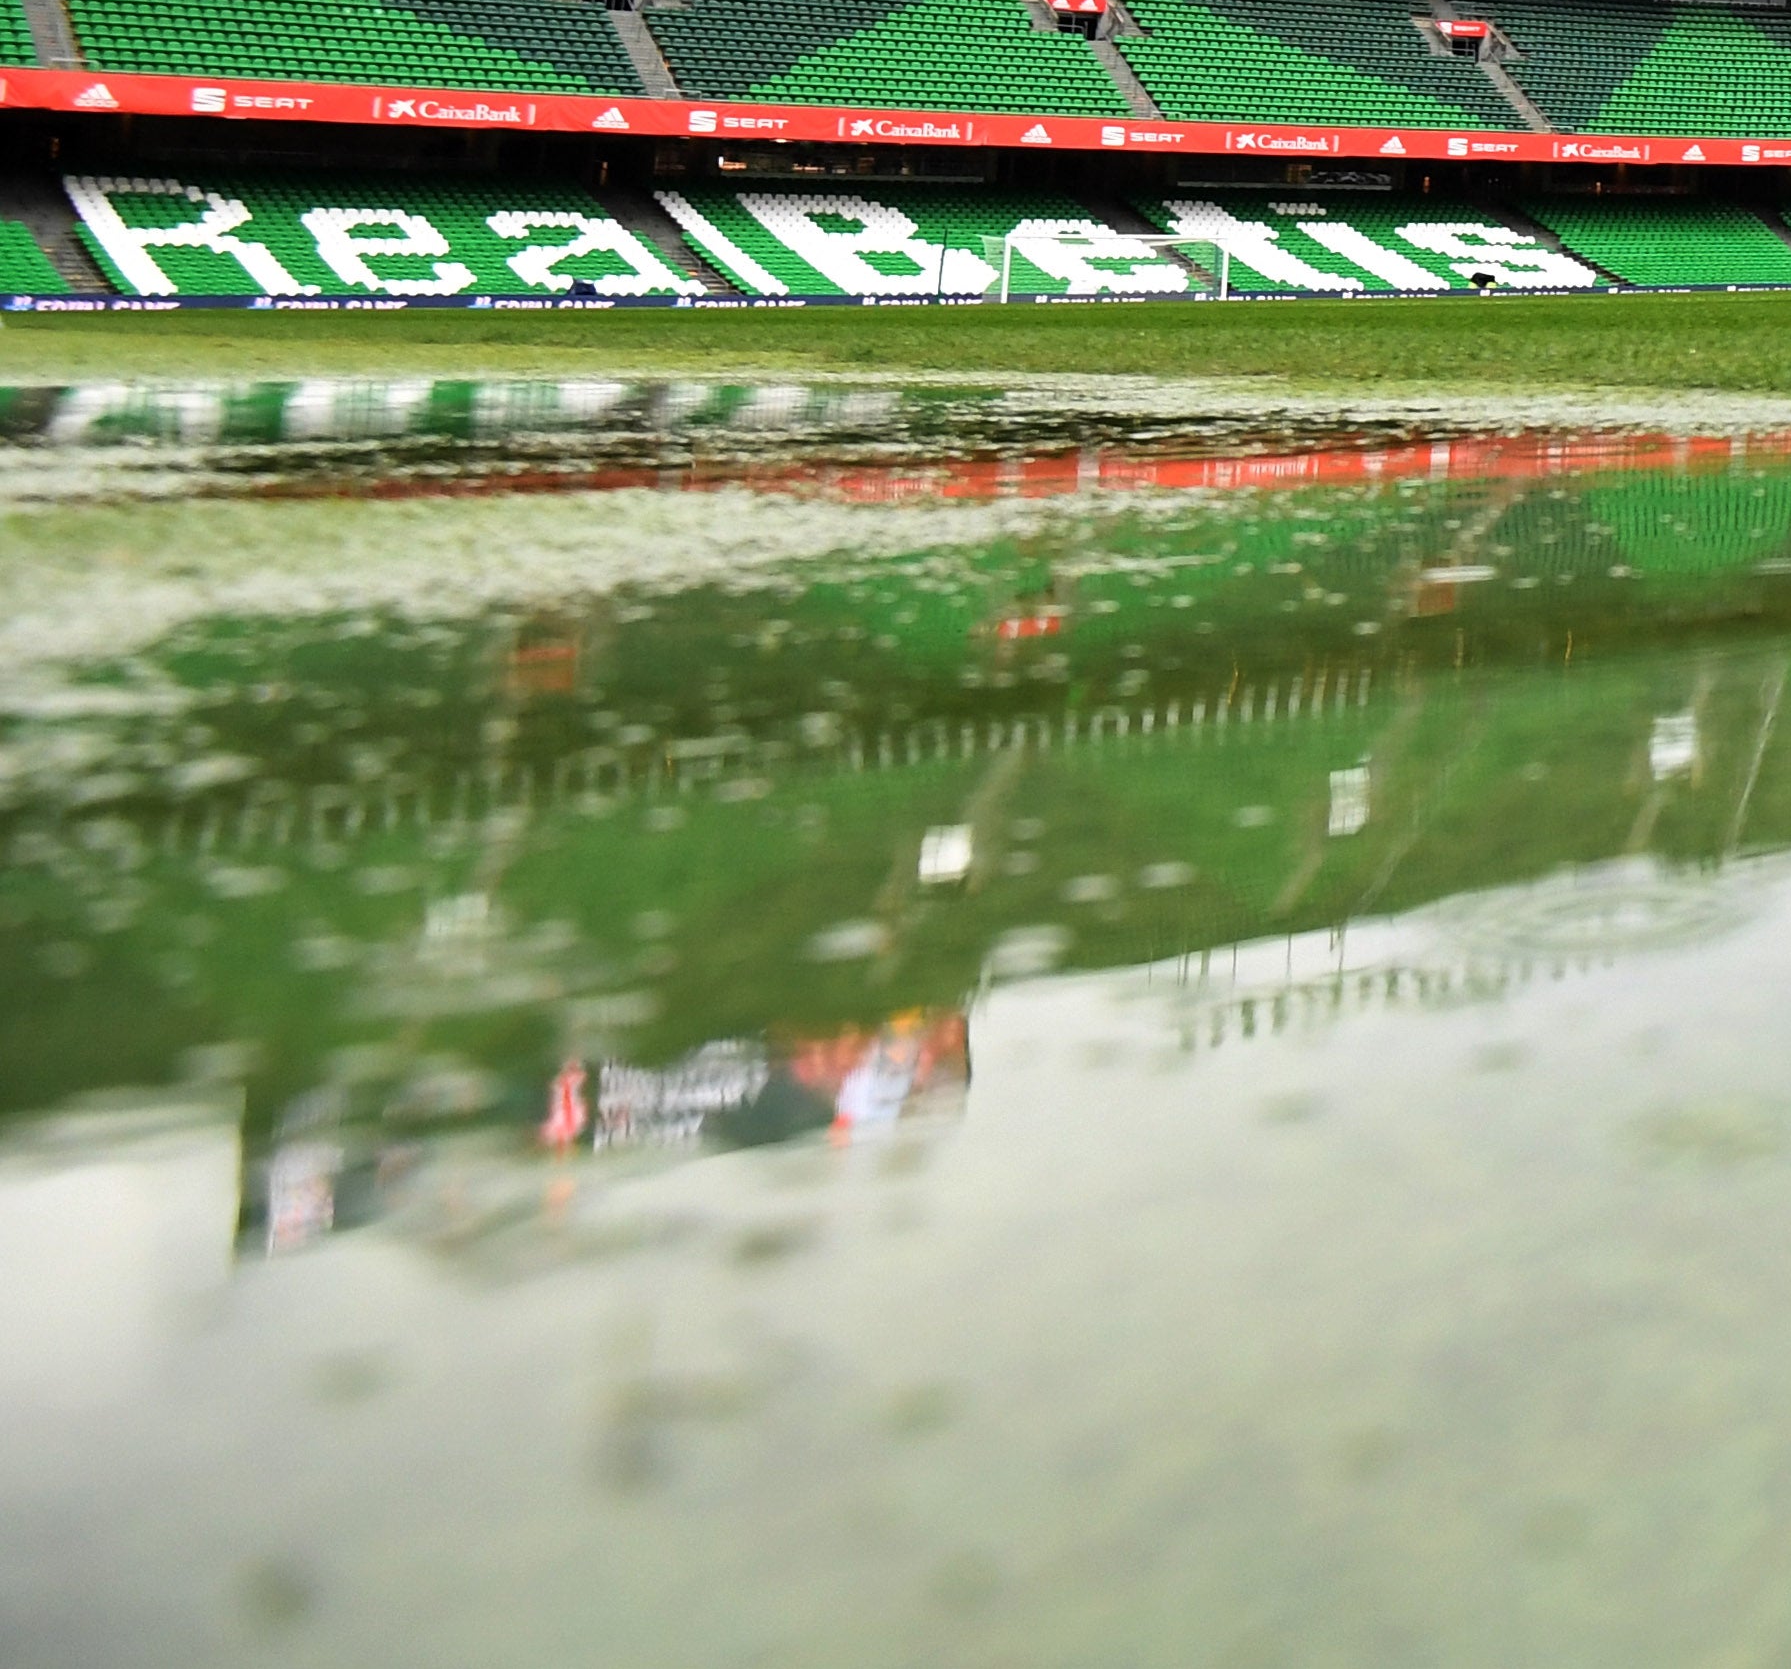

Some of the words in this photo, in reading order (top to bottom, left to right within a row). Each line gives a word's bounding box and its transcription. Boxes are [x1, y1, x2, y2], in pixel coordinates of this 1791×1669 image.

[232, 95, 314, 110] SEAT
[418, 100, 522, 123] CaixaBank
[722, 116, 789, 130] SEAT
[875, 120, 961, 139] CaixaBank
[1129, 131, 1185, 143] SEAT
[1256, 133, 1330, 151] CaixaBank
[1470, 142, 1519, 153] SEAT
[63, 174, 790, 297] Real
